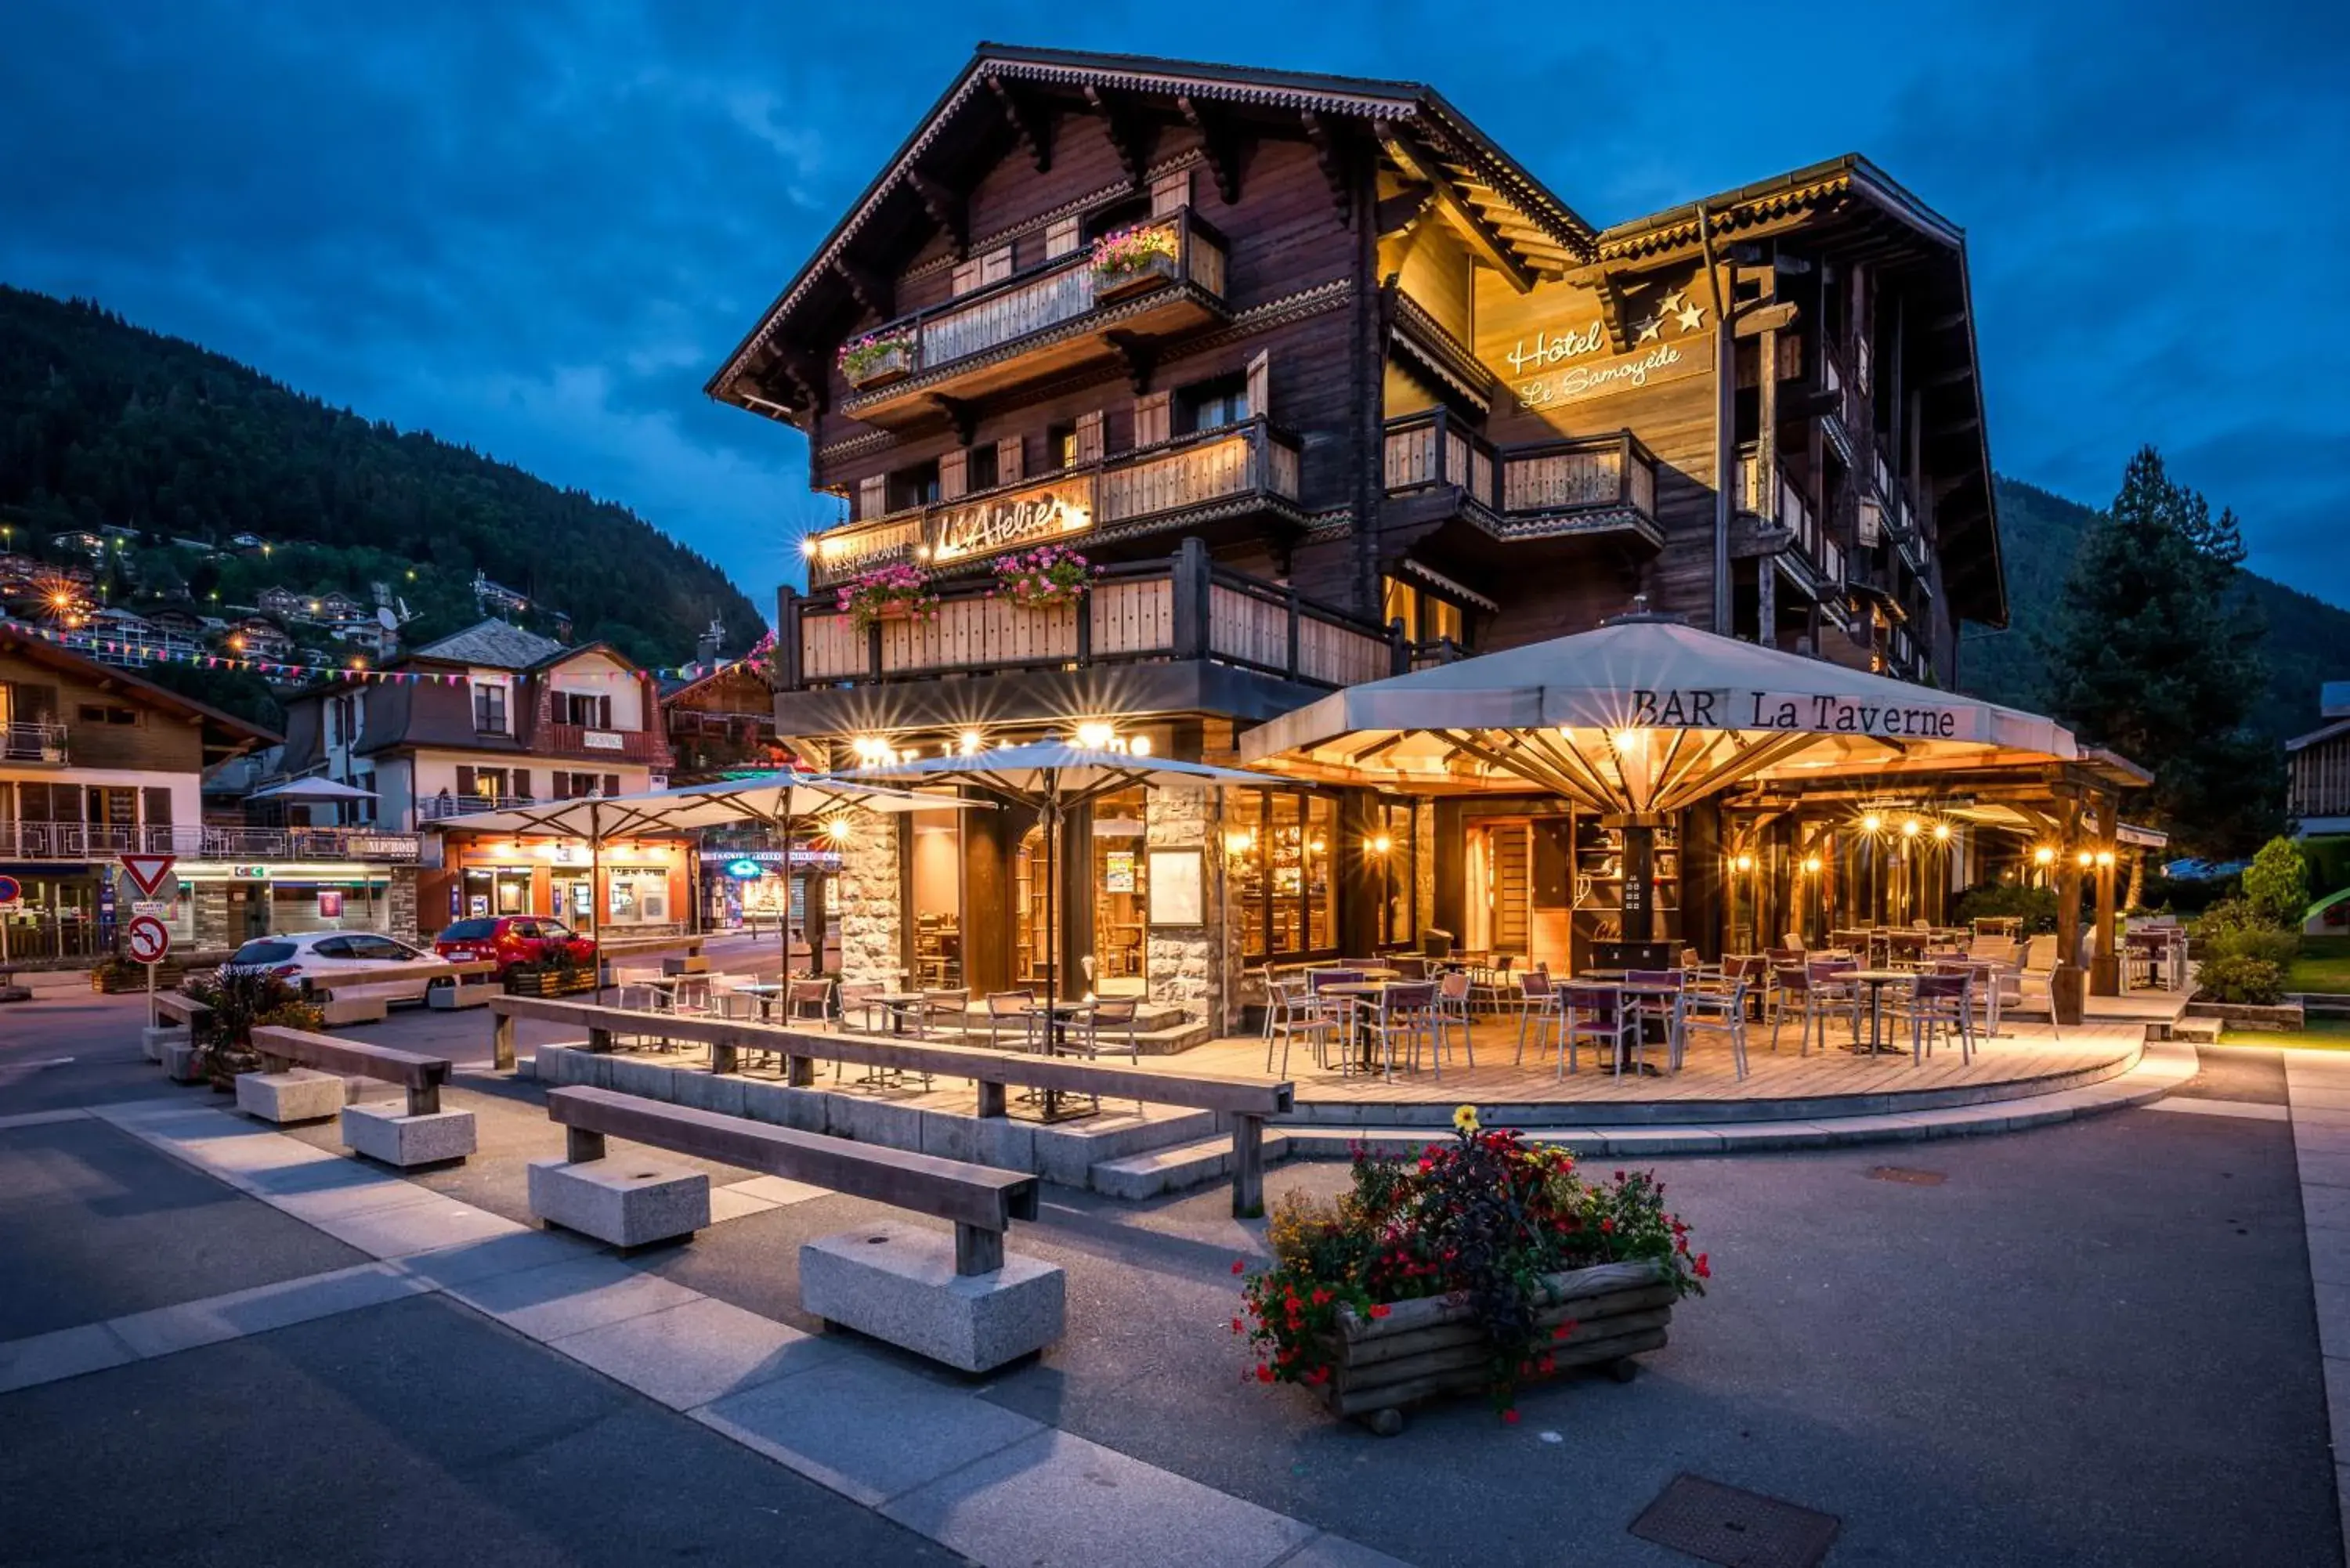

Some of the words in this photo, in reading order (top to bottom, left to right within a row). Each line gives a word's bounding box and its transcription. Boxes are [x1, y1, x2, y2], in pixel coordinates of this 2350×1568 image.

[1508, 320, 1605, 374] Hôtel
[1519, 381, 1555, 408] Le
[1564, 343, 1682, 395] Samoyède
[938, 499, 1068, 551] L'Atelier
[826, 542, 904, 573] RESTAURANT
[1633, 690, 1718, 727] BAR
[1750, 692, 1799, 730] La
[1812, 695, 1955, 737] Taverne
